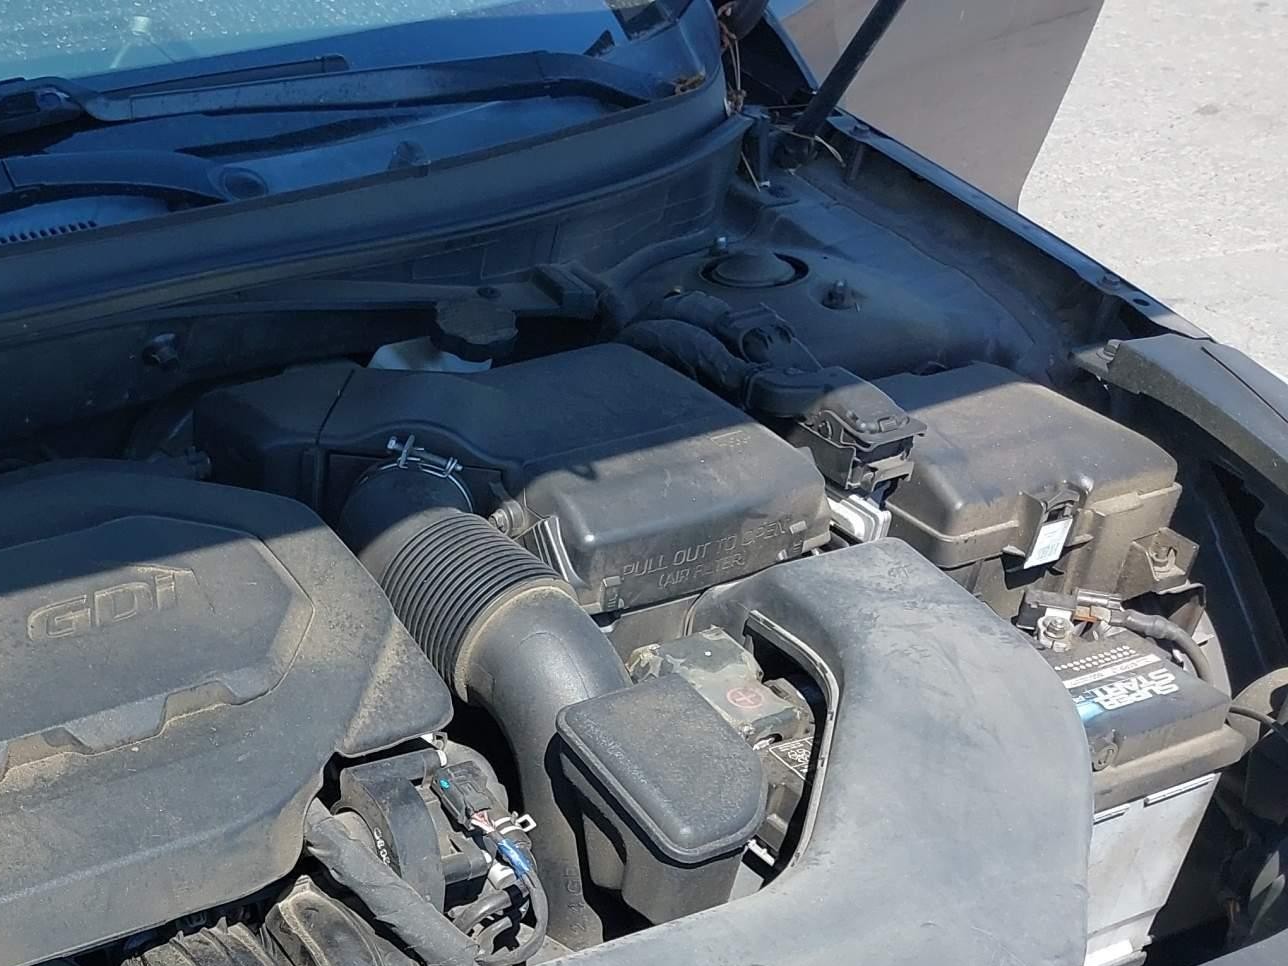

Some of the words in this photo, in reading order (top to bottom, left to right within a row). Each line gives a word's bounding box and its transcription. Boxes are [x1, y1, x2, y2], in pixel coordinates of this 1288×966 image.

[623, 554, 668, 576] PULL
[673, 541, 711, 566] OUT
[1092, 667, 1176, 701] START
[1093, 683, 1179, 710] SUPER
